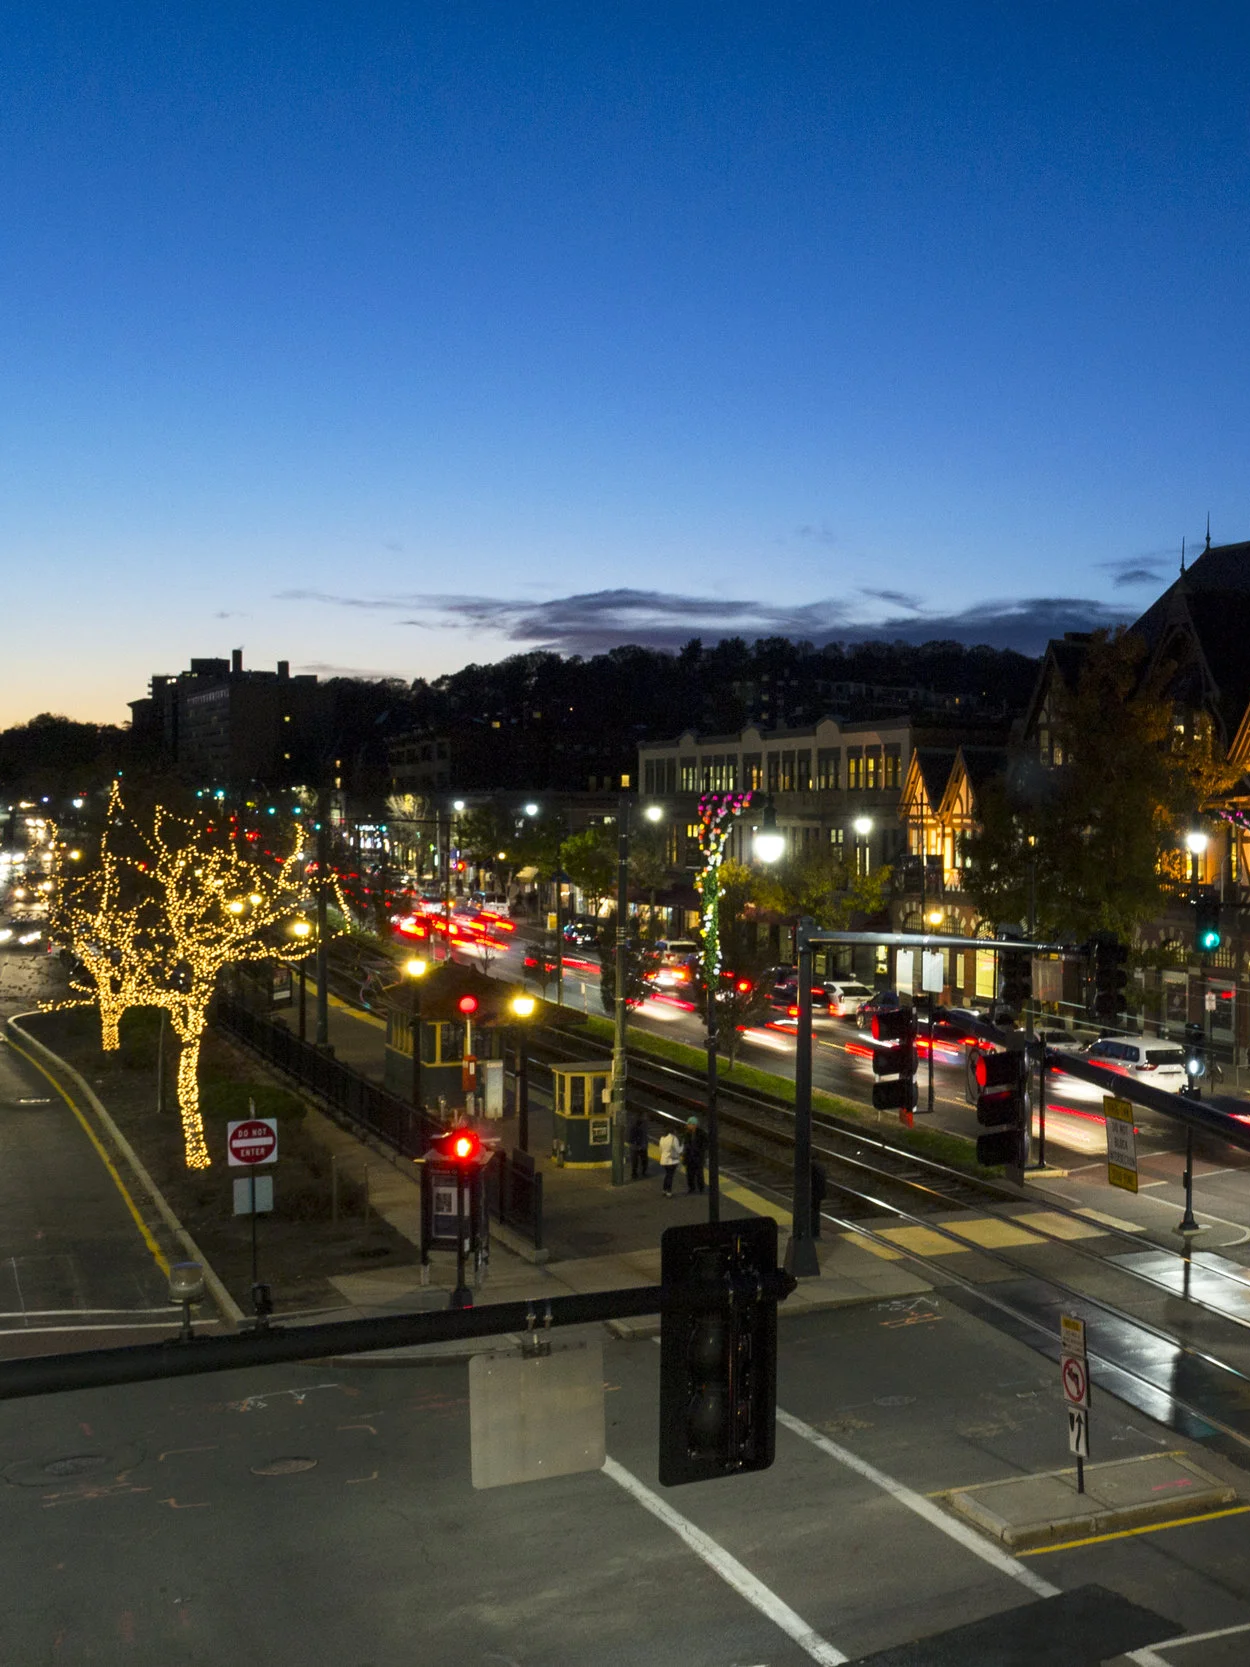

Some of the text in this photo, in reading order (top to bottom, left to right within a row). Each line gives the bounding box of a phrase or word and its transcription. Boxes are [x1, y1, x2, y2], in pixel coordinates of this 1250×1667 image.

[238, 1127, 267, 1138] DO NOT
[240, 1147, 266, 1158] ENTER
